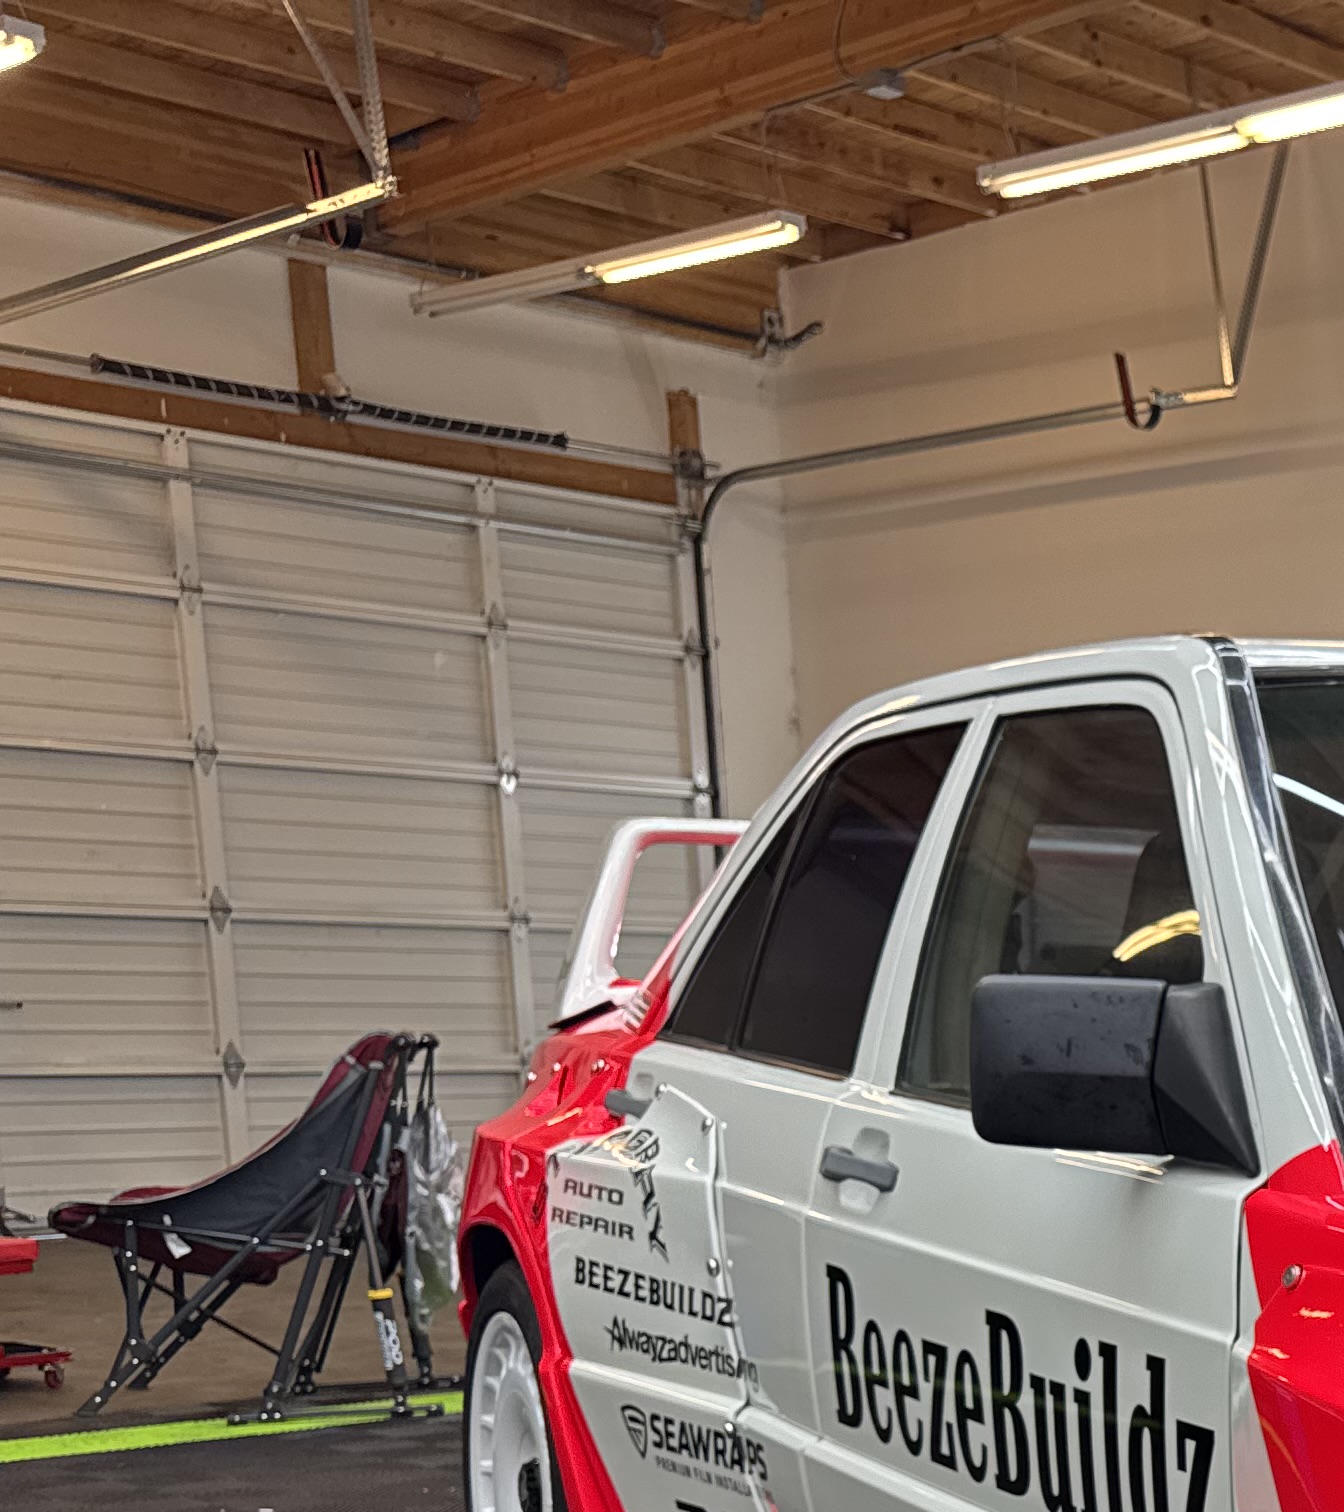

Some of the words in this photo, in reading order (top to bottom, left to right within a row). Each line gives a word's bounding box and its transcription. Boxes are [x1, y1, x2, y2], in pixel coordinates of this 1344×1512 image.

[563, 1178, 625, 1206] AUTO
[551, 1205, 635, 1241] REPAIR
[574, 1254, 736, 1329] BEEZEBUILDZ
[650, 1412, 768, 1482] SEAWRAPS
